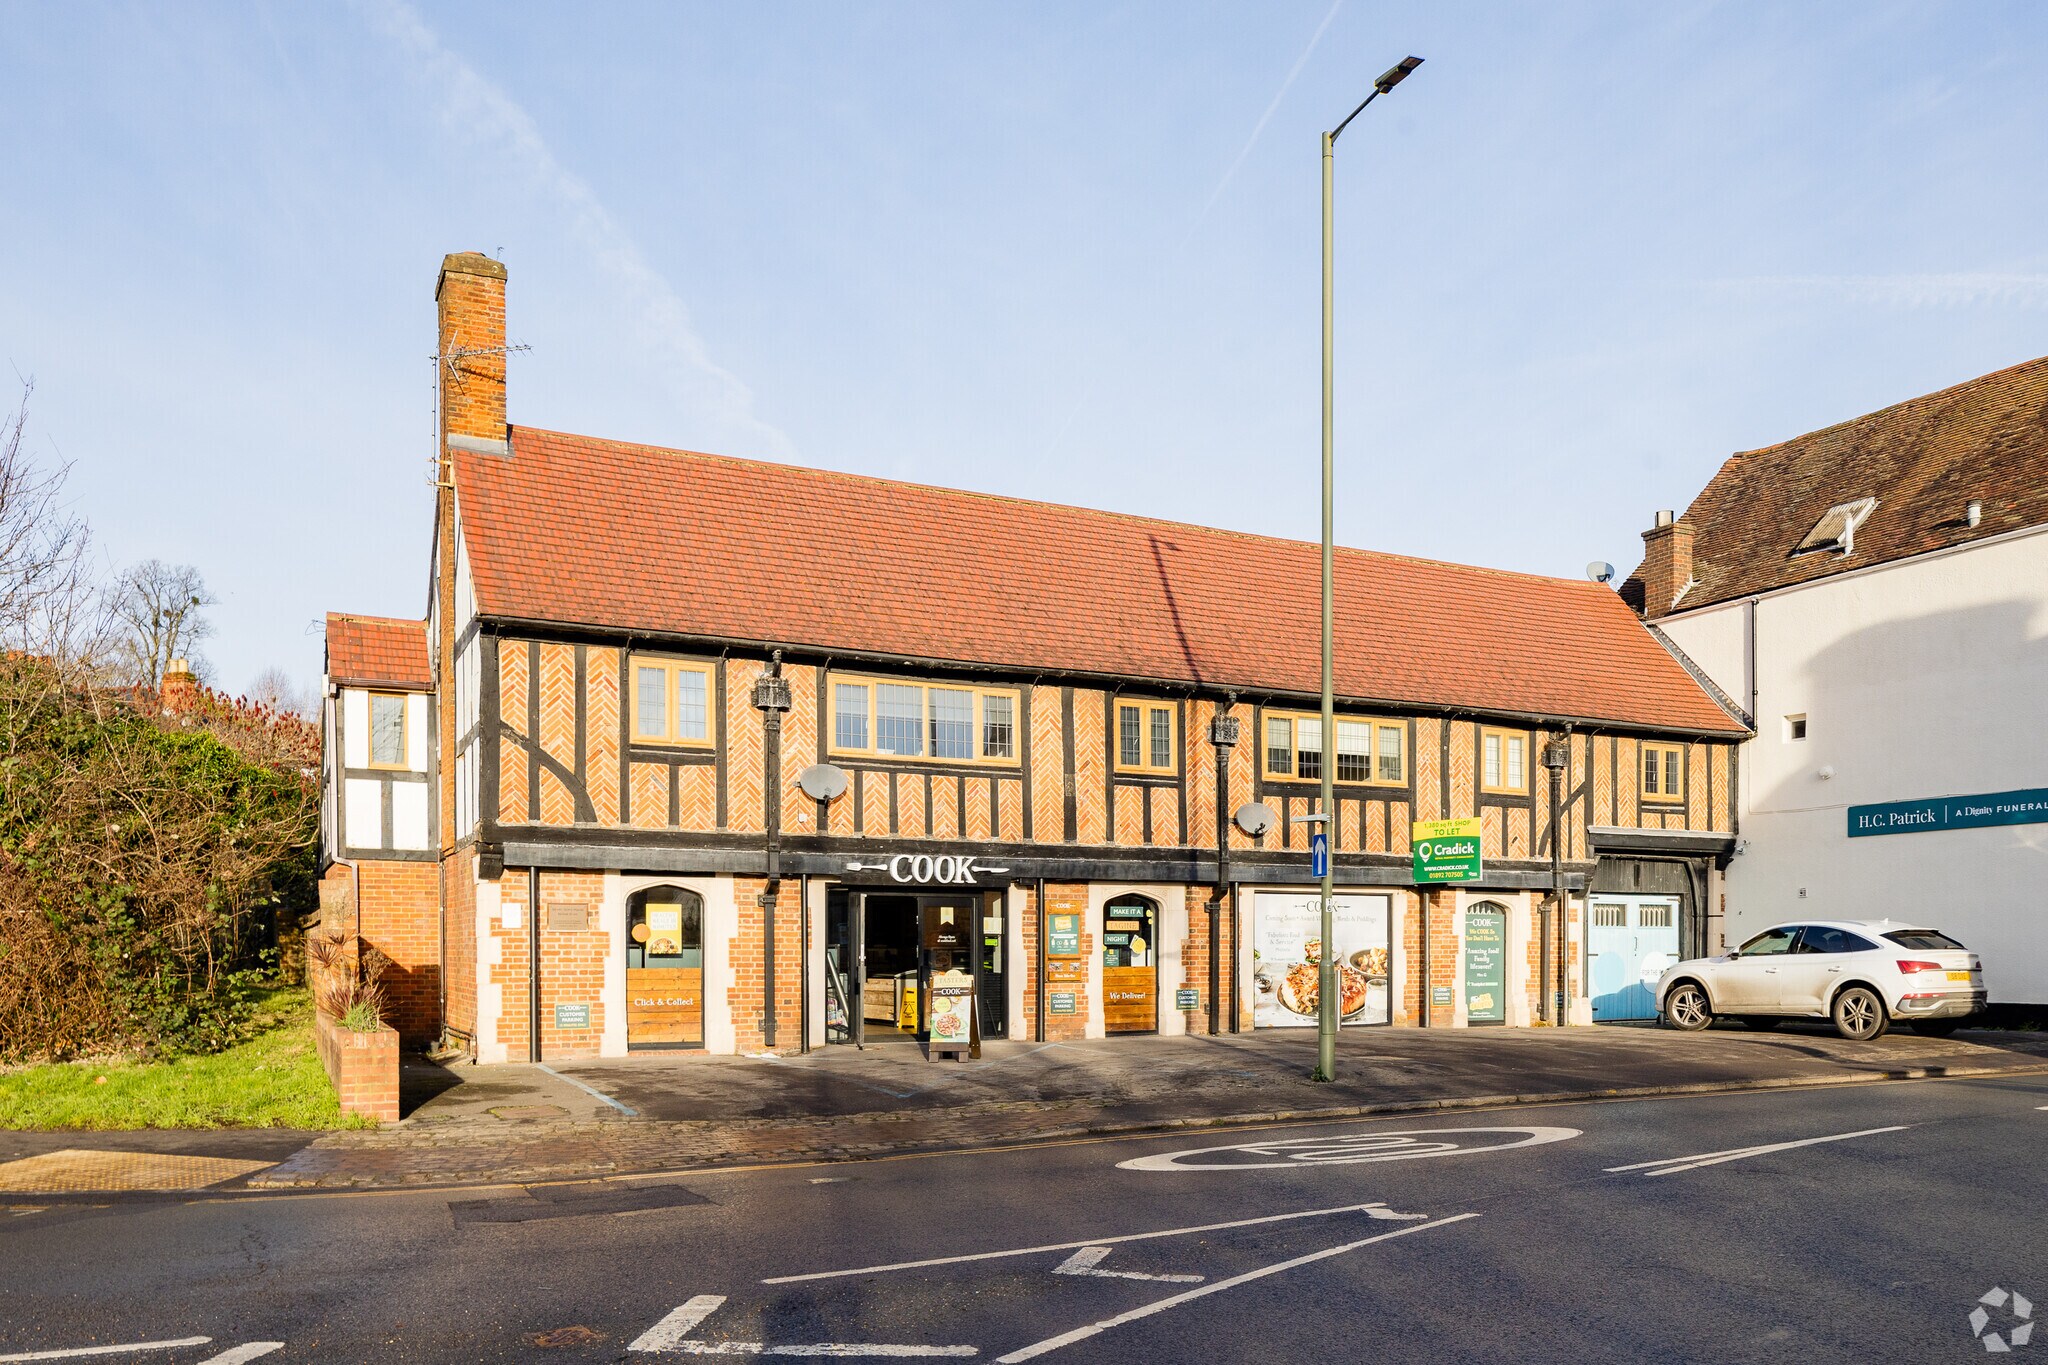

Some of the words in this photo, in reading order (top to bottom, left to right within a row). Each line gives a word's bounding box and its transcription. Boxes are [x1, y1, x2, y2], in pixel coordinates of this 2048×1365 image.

[1955, 809, 1962, 817] A
[1965, 806, 1993, 816] Dignity
[1996, 802, 2048, 813] FUNERAL
[1859, 813, 1885, 828] H.C.
[1889, 808, 1936, 826] Patrick
[1446, 828, 1460, 836] LET
[1434, 842, 1475, 855] Cradick
[890, 854, 977, 884] COOK
[634, 998, 655, 1006] Click
[657, 998, 664, 1006] &
[666, 997, 694, 1006] Collect
[1236, 1136, 1460, 1161] 20
